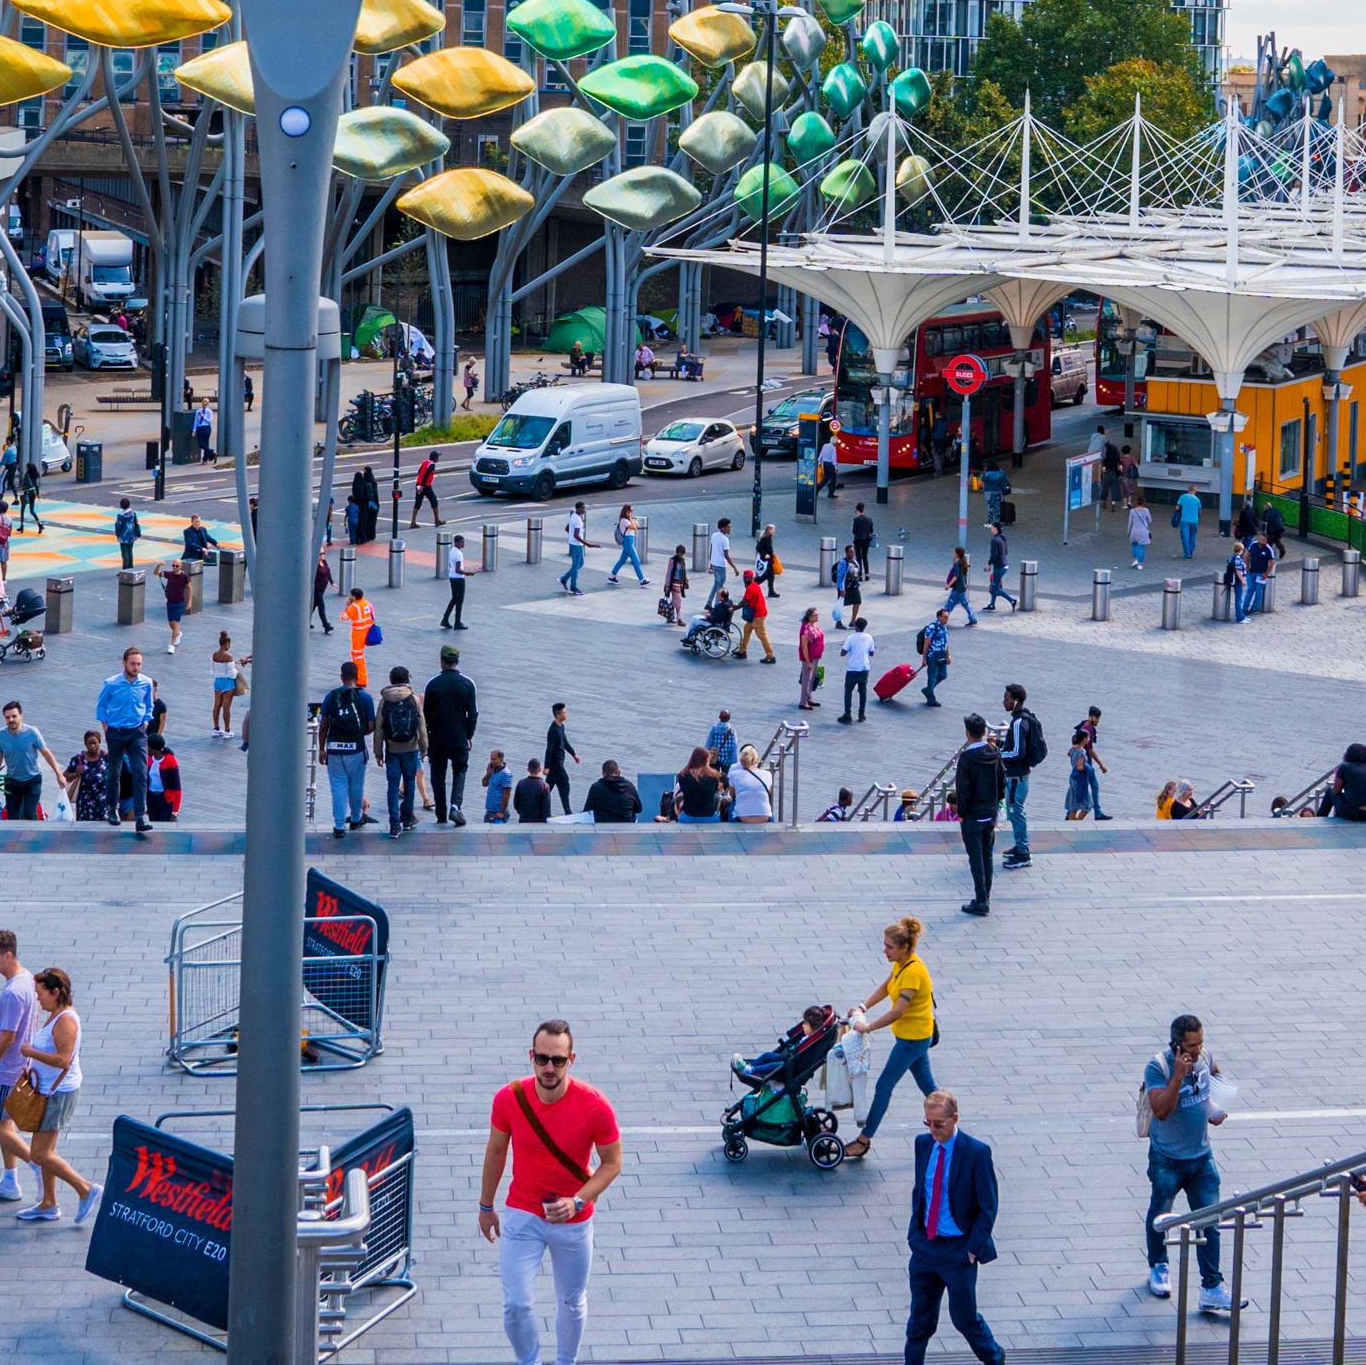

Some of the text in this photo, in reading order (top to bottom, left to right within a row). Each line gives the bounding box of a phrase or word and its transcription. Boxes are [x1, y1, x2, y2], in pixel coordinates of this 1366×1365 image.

[313, 891, 374, 956] Westfield
[109, 1201, 227, 1262] STRATFORD CITY E20
